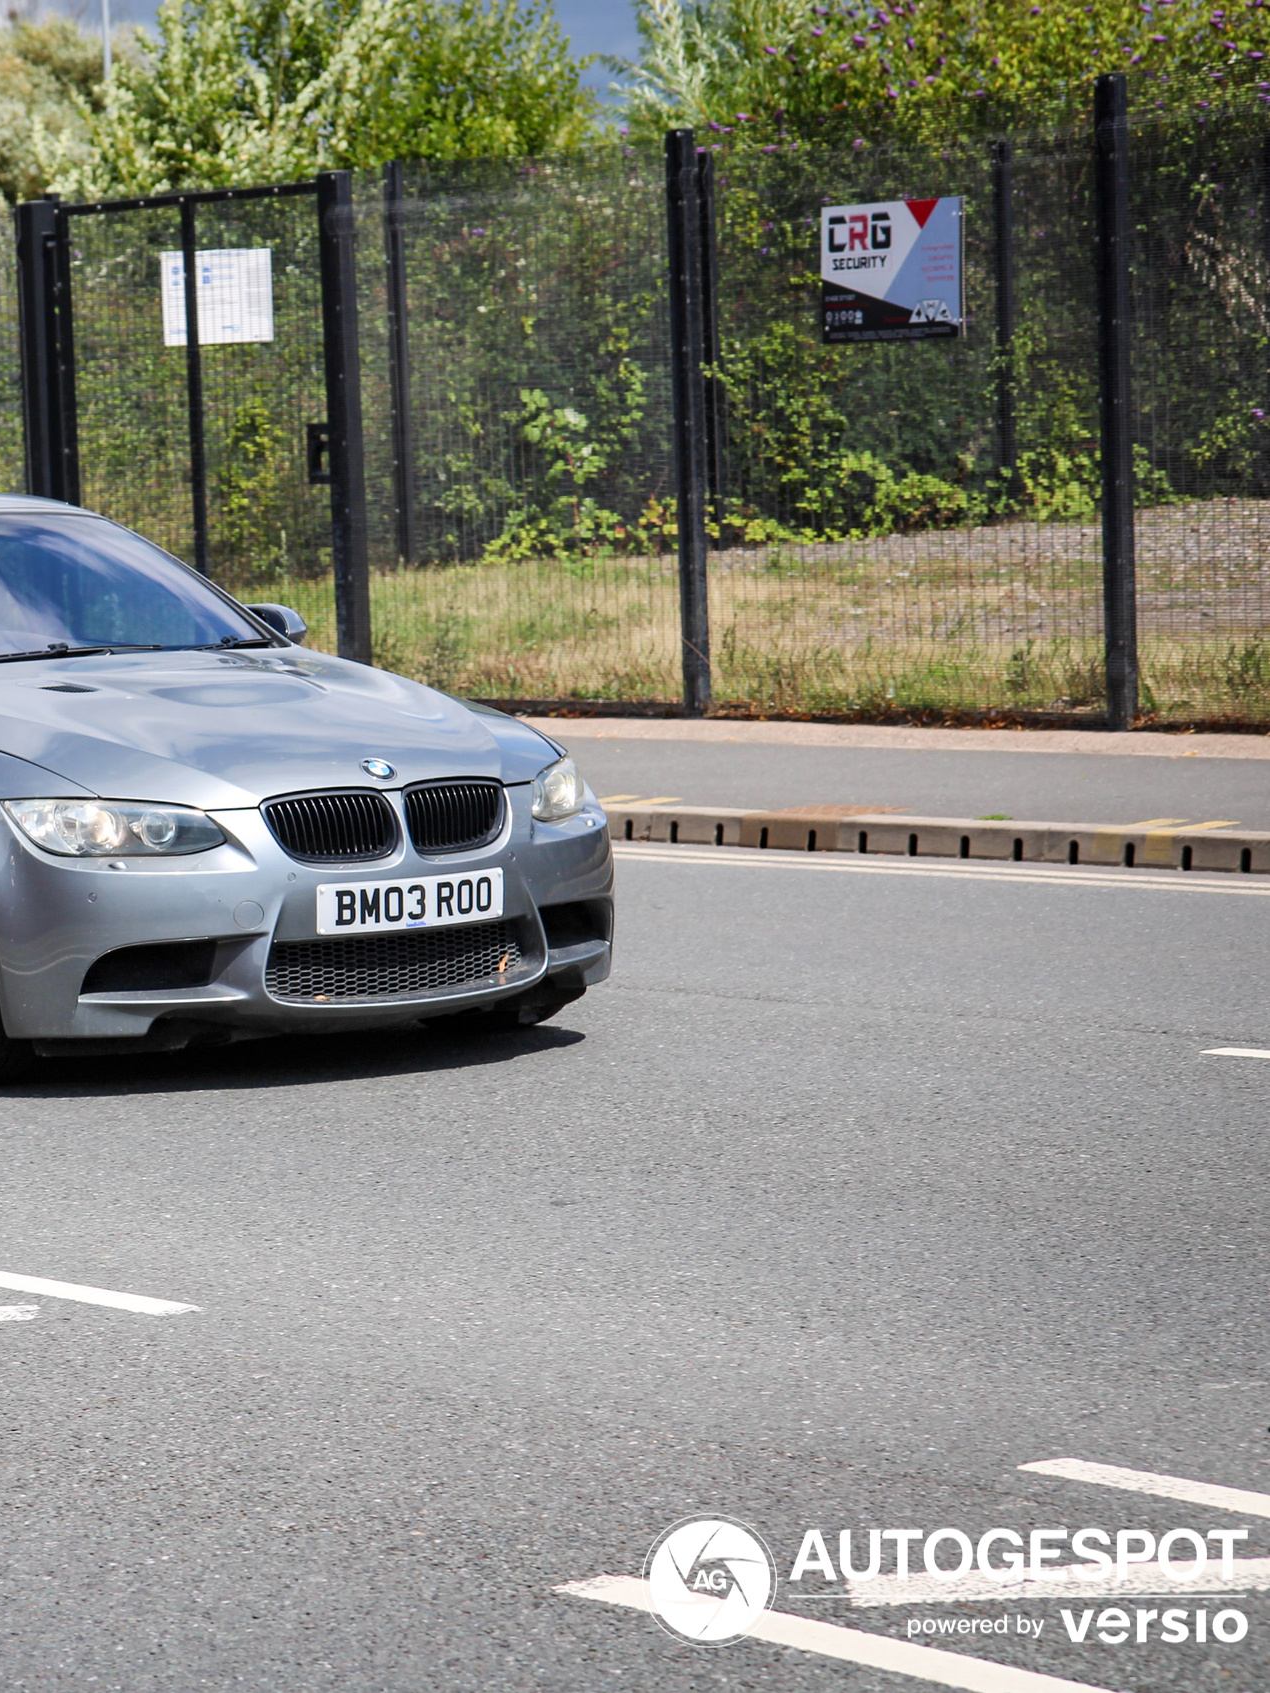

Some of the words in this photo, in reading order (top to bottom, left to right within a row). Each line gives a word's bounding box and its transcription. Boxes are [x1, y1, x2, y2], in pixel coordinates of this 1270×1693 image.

[828, 211, 892, 253] CRG
[832, 254, 887, 271] SECURITY
[335, 884, 426, 926] BM03
